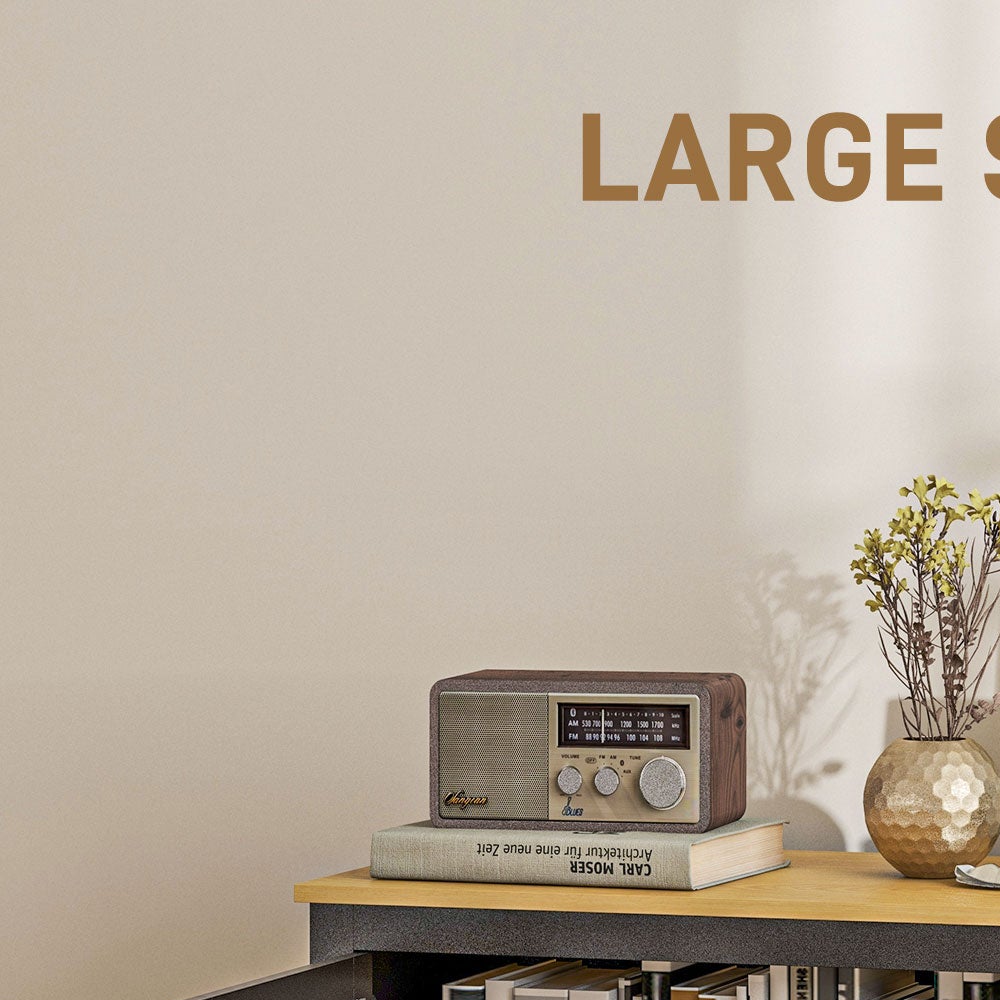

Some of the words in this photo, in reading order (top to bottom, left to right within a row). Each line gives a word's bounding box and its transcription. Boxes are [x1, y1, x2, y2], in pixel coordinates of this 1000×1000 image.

[568, 719, 579, 727] AM
[582, 719, 592, 728] 530
[620, 720, 632, 728] 1200
[637, 720, 649, 729] 1500
[651, 720, 664, 729] 1700
[568, 733, 579, 741] FM
[477, 843, 500, 857] Zeit
[503, 843, 532, 855] neue
[535, 844, 561, 859] eine
[564, 845, 582, 860] für
[585, 847, 653, 862] Architektur
[570, 861, 614, 875] MOSER
[619, 862, 652, 876] CARL
